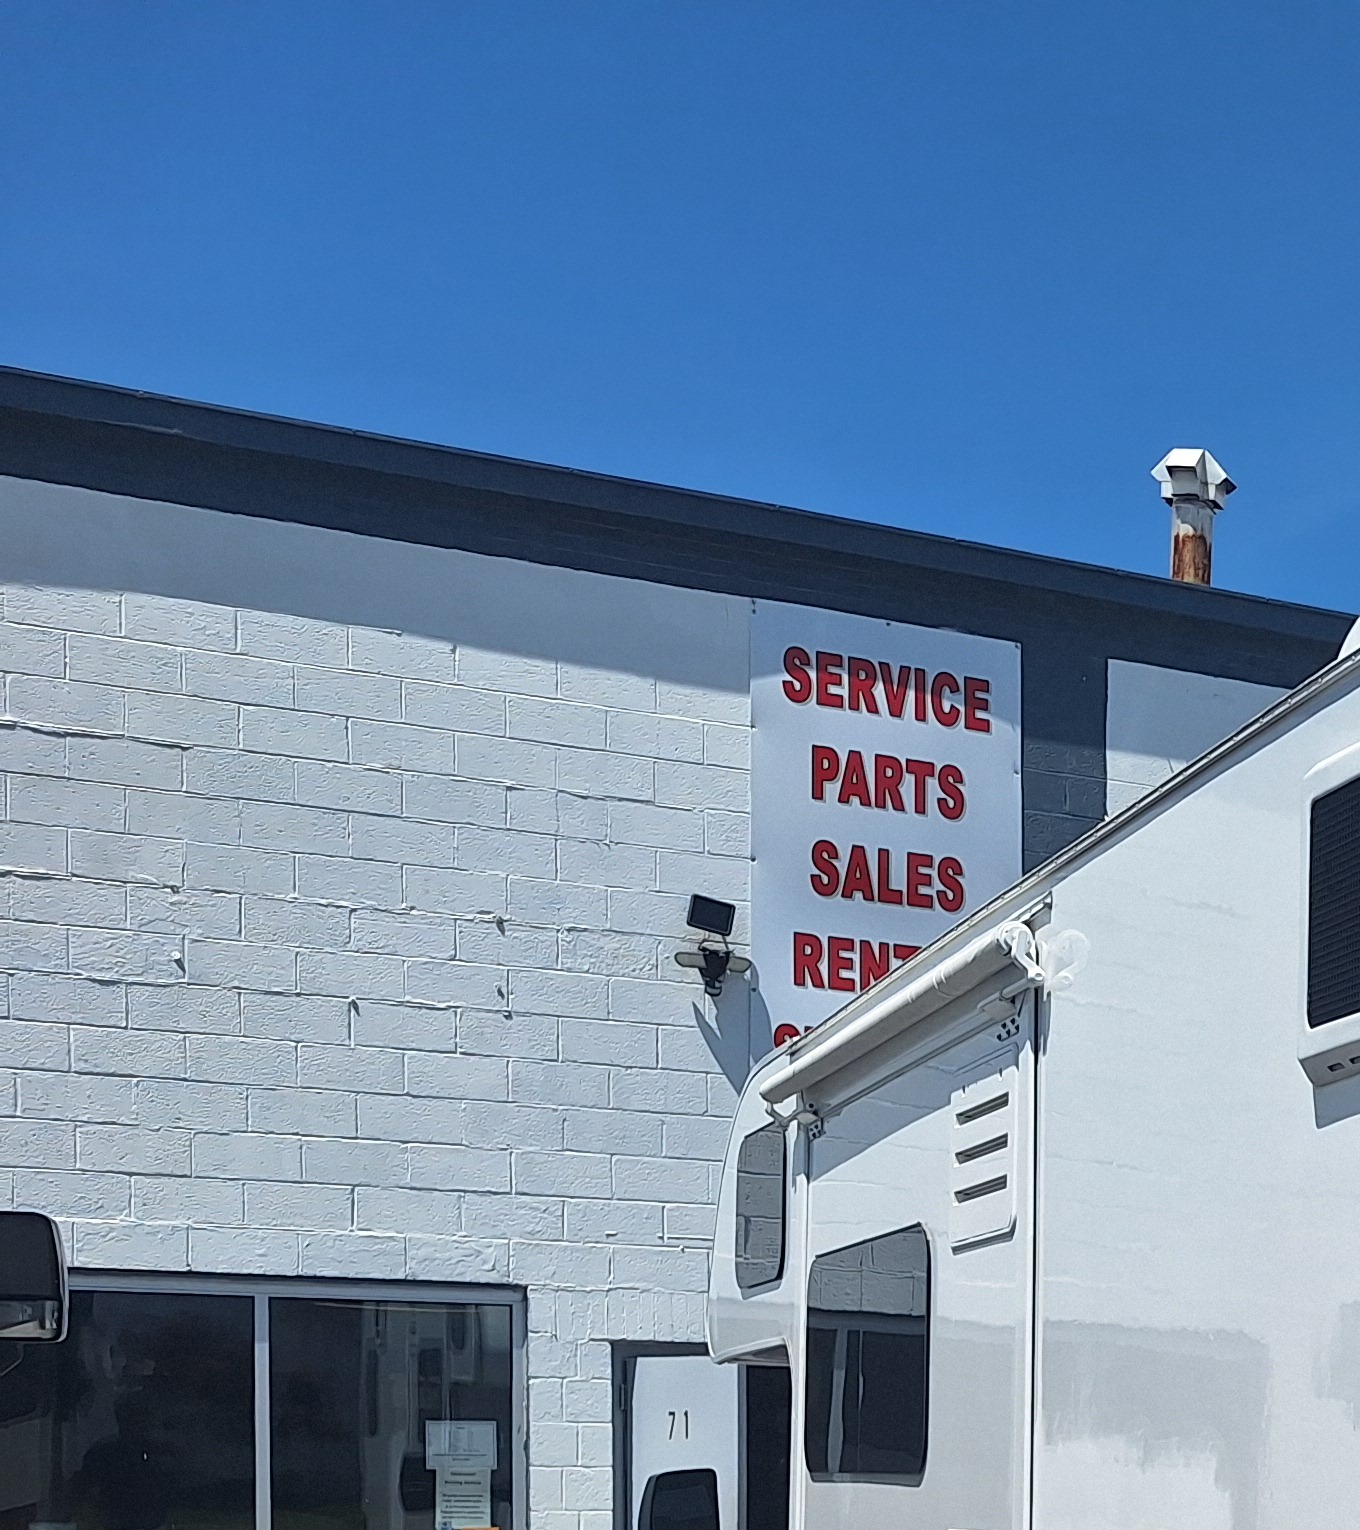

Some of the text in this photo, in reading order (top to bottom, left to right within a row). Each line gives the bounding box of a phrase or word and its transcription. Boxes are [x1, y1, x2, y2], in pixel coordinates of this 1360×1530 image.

[782, 646, 991, 733] SERVICE
[811, 744, 964, 821] PARTS
[809, 839, 964, 913] SALES
[668, 1410, 689, 1440] 71
